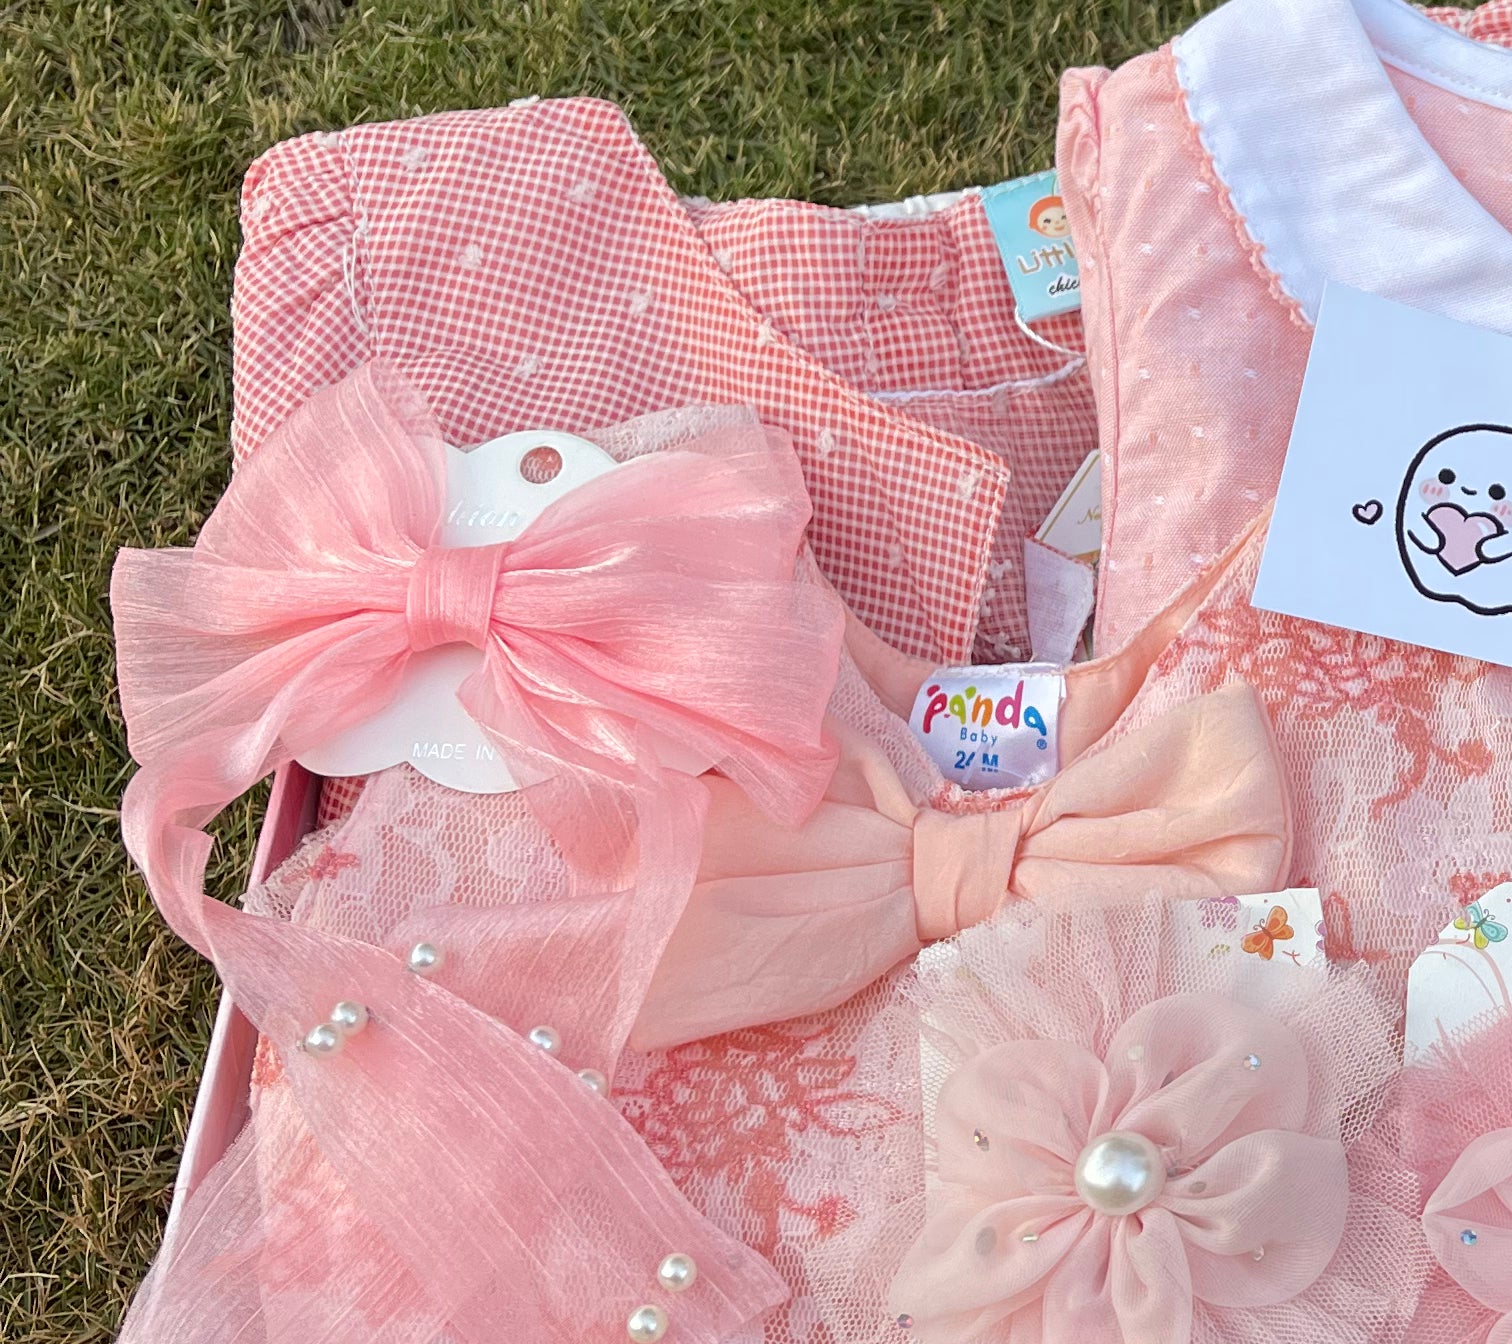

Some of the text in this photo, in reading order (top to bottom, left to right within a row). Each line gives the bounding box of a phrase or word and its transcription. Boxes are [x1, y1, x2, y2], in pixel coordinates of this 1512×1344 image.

[1018, 242, 1076, 274] Littl
[1049, 275, 1080, 296] chic
[923, 680, 1047, 737] panda
[960, 727, 998, 746] Baby
[412, 742, 495, 760] MADE IN
